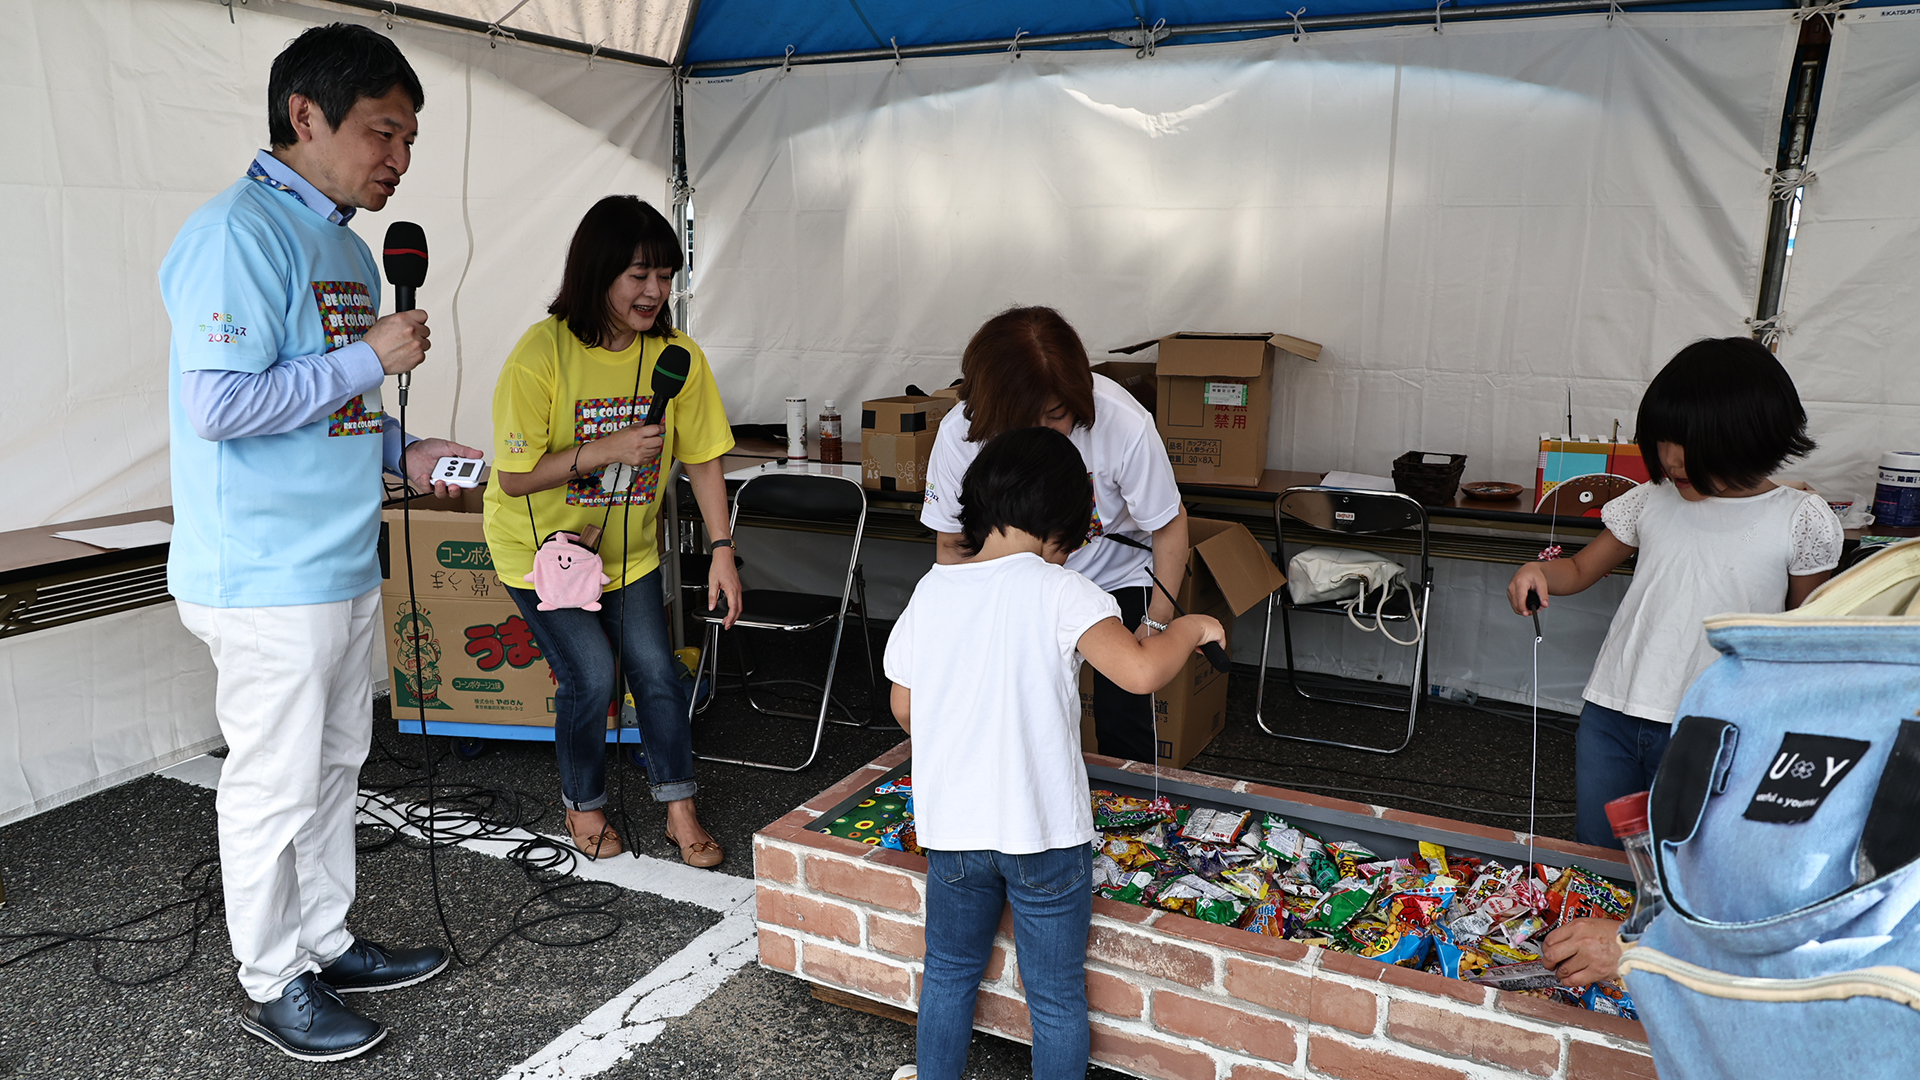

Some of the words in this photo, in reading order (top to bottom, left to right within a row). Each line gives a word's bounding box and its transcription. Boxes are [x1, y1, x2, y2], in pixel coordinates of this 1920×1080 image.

[323, 293, 339, 306] BE
[213, 312, 233, 323] RKB
[329, 314, 345, 328] BE
[208, 333, 237, 344] 2024
[334, 335, 348, 348] BE
[583, 408, 597, 419] BE
[599, 405, 651, 417] COLORFU
[583, 424, 597, 434] BE
[1169, 442, 1182, 450] 品名
[926, 482, 935, 490] KB
